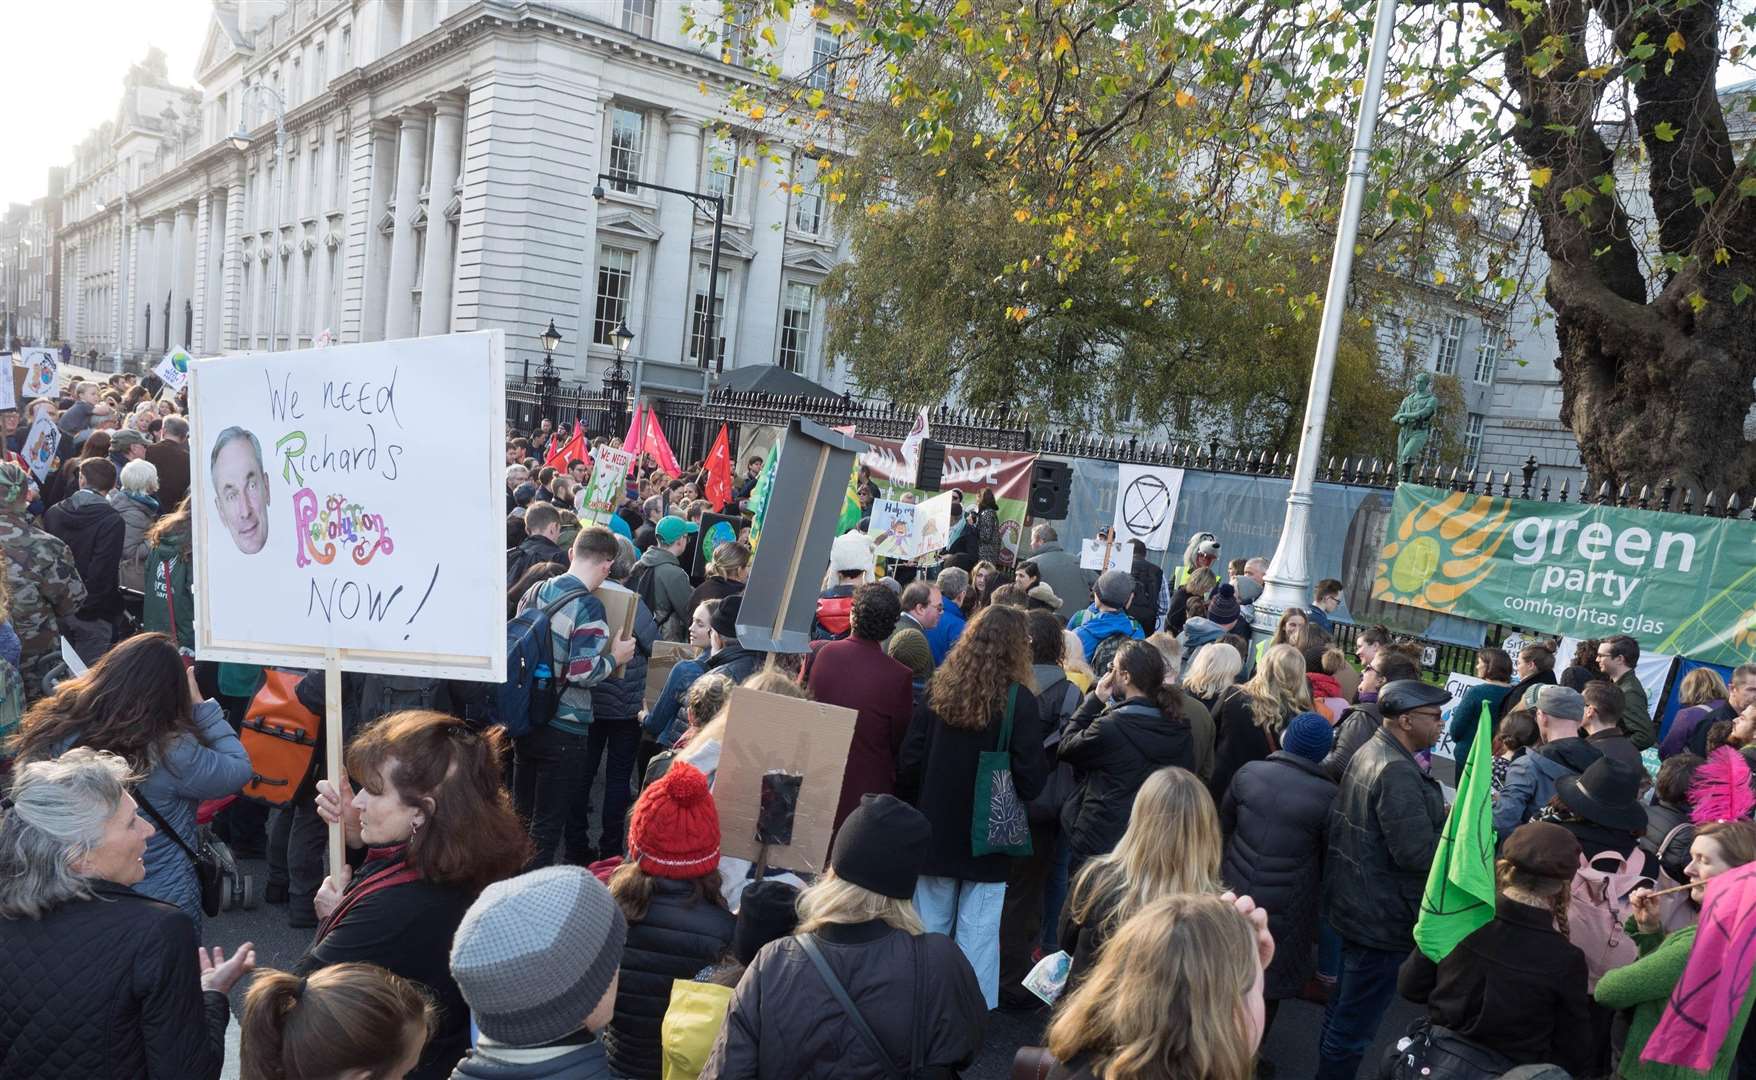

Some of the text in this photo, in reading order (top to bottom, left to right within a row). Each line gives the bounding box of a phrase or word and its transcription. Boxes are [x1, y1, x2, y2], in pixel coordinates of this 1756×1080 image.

[265, 368, 304, 421] We
[276, 424, 403, 487] Richards
[293, 488, 394, 568] Revolution
[1512, 516, 1696, 572] green
[308, 563, 440, 640] NOW!
[1541, 565, 1641, 606] party
[1503, 594, 1665, 636] comhaontas glas
